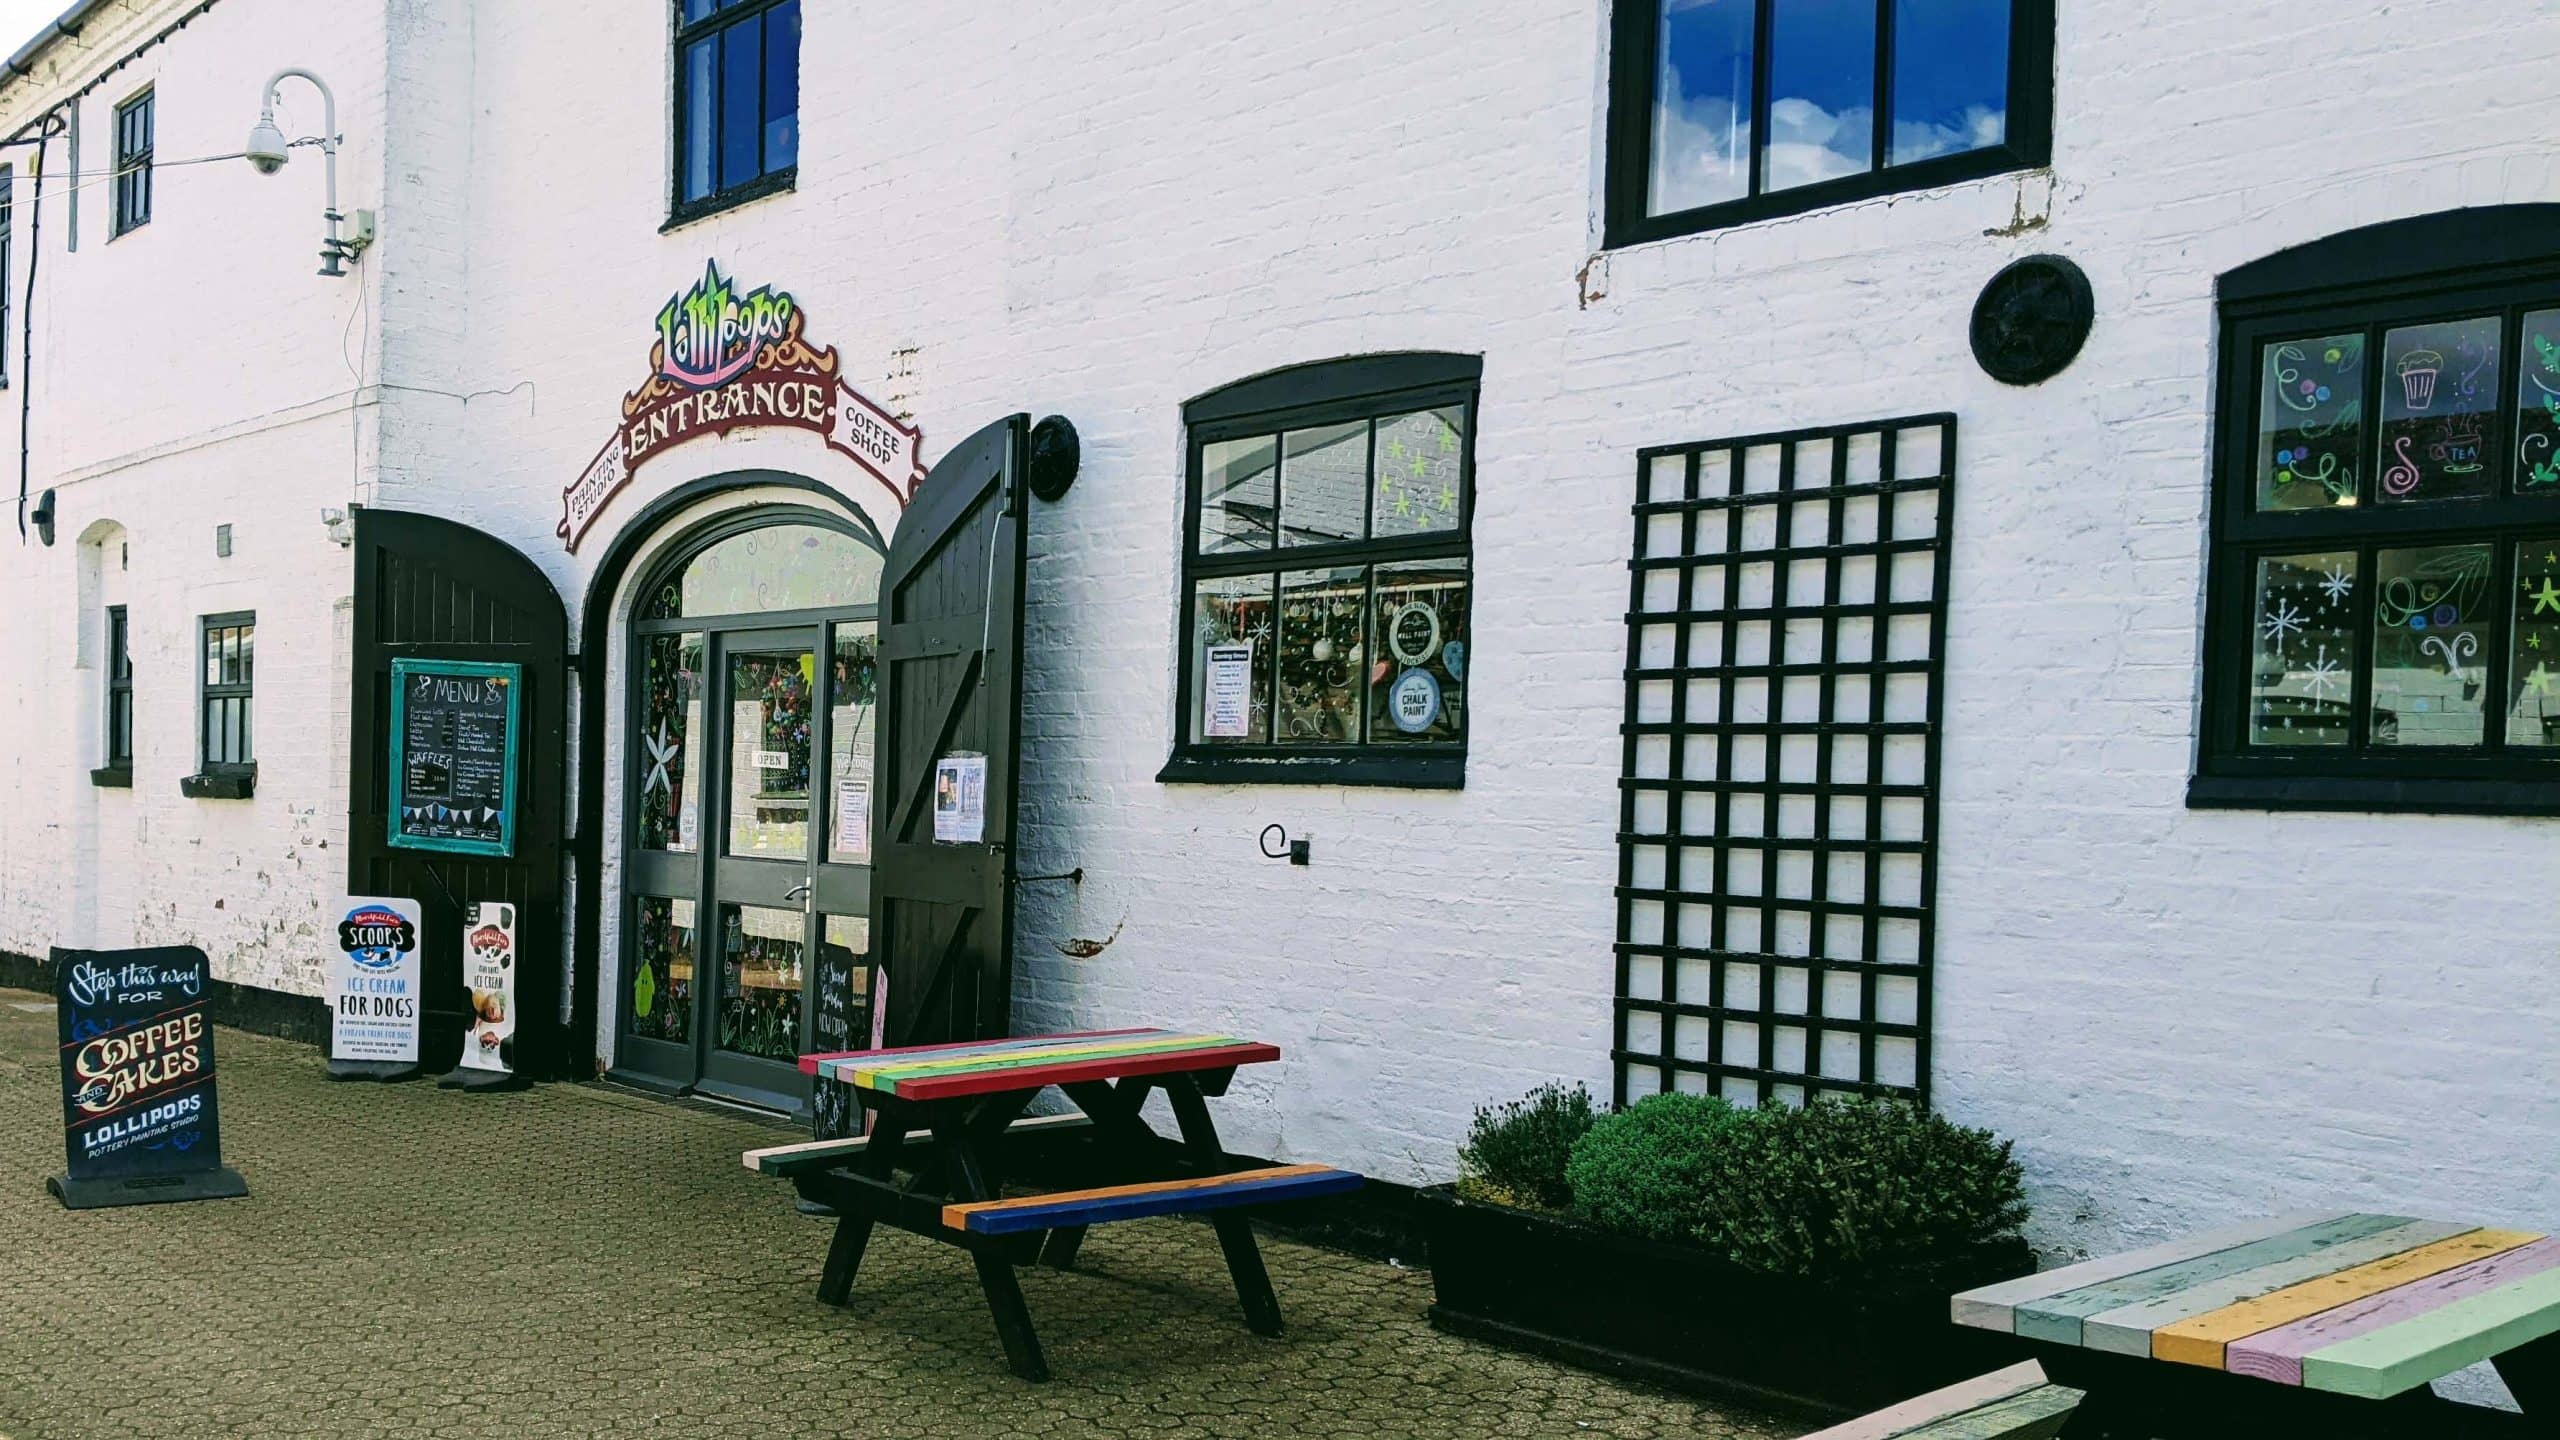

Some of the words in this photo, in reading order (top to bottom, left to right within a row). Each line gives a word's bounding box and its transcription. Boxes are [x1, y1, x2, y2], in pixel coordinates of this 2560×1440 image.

[628, 381, 825, 459] ENTRANCE
[845, 405, 900, 456] COFFEE
[850, 430, 893, 464] SHOP
[2450, 446, 2476, 460] TEA
[571, 446, 620, 513] PAINTING
[577, 467, 616, 520] STUDIO
[1413, 629, 1431, 639] PAINT
[434, 679, 479, 703] MENU
[1402, 694, 1427, 706] CHALK
[1403, 705, 1426, 717] PAINT
[408, 752, 452, 769] WAFFLES
[757, 755, 782, 766] OPEN
[69, 961, 116, 1005] Step
[121, 963, 158, 989] this
[160, 963, 200, 995] way
[347, 977, 365, 992] ICE
[369, 978, 406, 994] CREAM
[474, 974, 483, 988] ICE
[484, 975, 504, 989] CREAM
[117, 991, 163, 1005] FOR
[340, 995, 368, 1015] FOR
[374, 997, 413, 1018] DOGS
[76, 1012, 203, 1078] COFFEE
[79, 1045, 200, 1113] CAKES
[77, 1086, 104, 1104] AND
[83, 1094, 201, 1149] LOLLIPOPS
[88, 1138, 129, 1160] POTTERY
[130, 1125, 169, 1146] PAINTING
[170, 1114, 199, 1131] STUDIO
